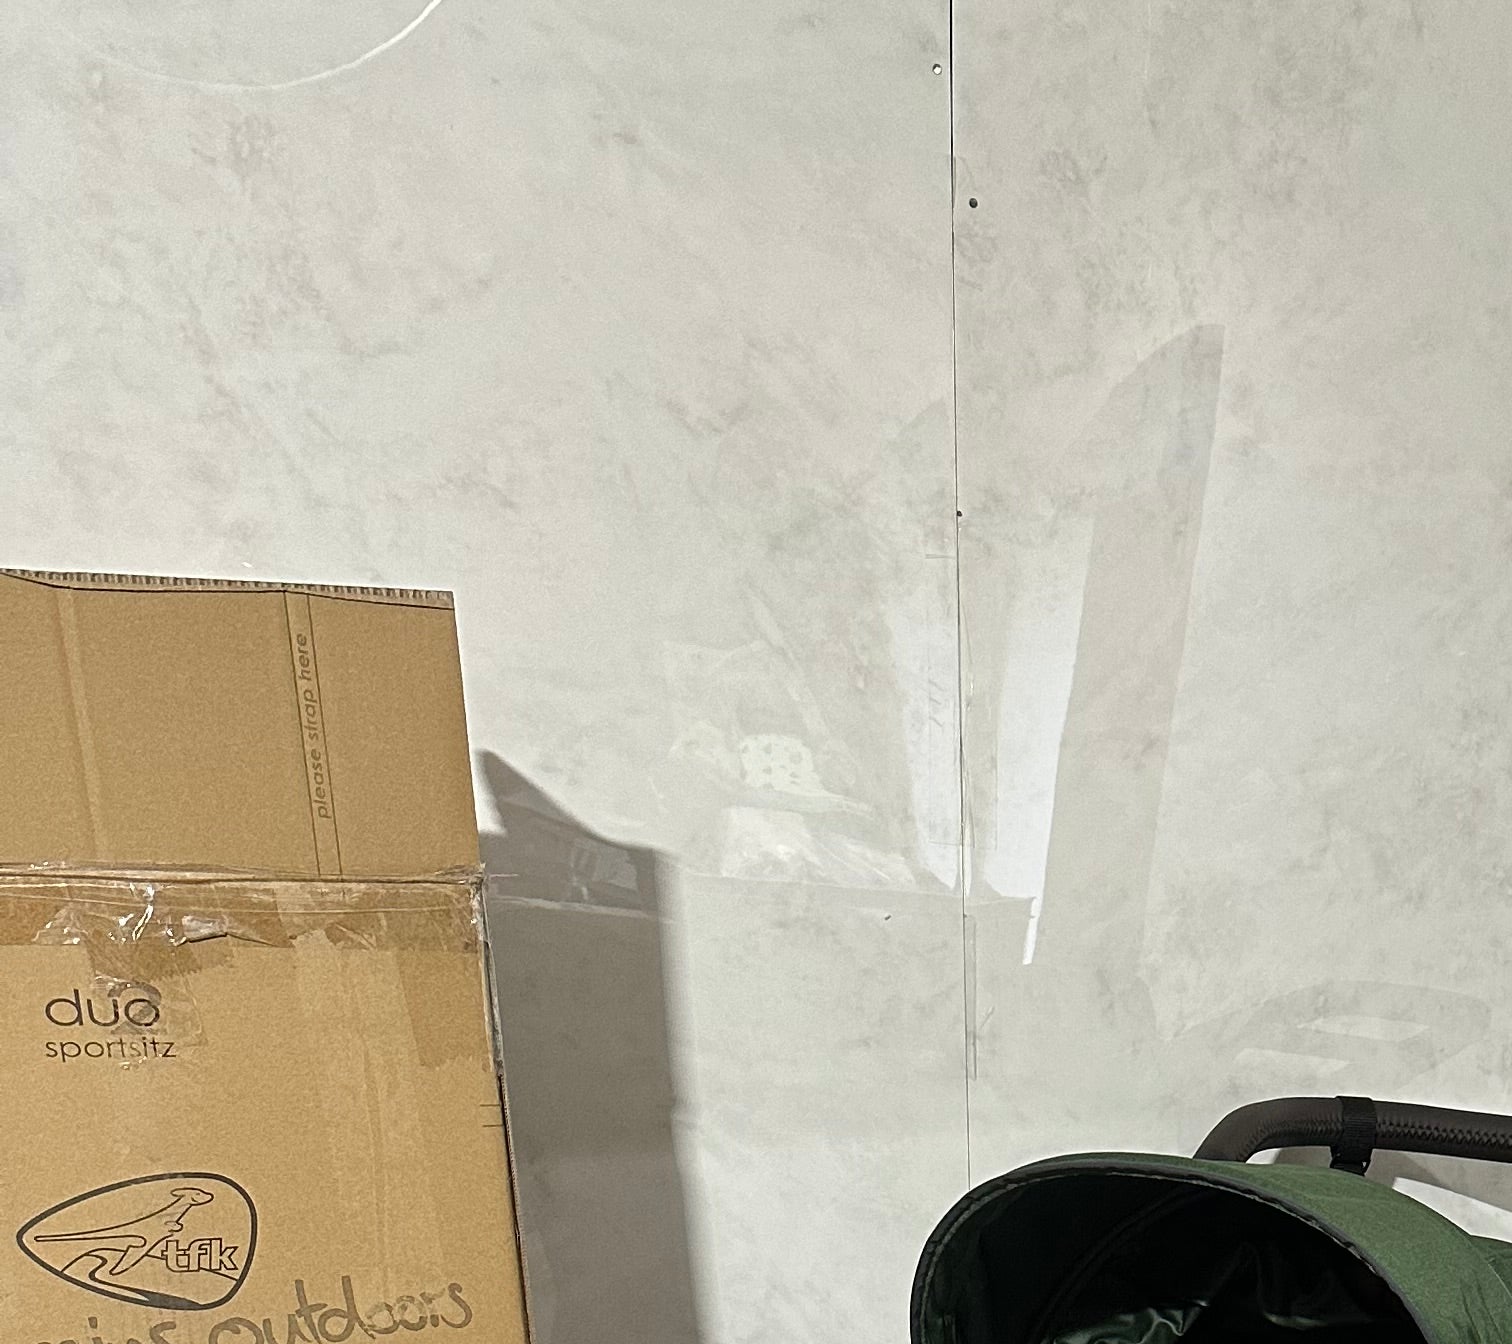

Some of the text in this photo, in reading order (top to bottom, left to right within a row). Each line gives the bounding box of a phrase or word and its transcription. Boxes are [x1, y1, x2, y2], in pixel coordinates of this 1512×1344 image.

[297, 633, 332, 819] please strap here
[45, 988, 160, 1027] duo
[46, 1036, 177, 1063] sportsitz
[161, 1237, 239, 1272] tfk
